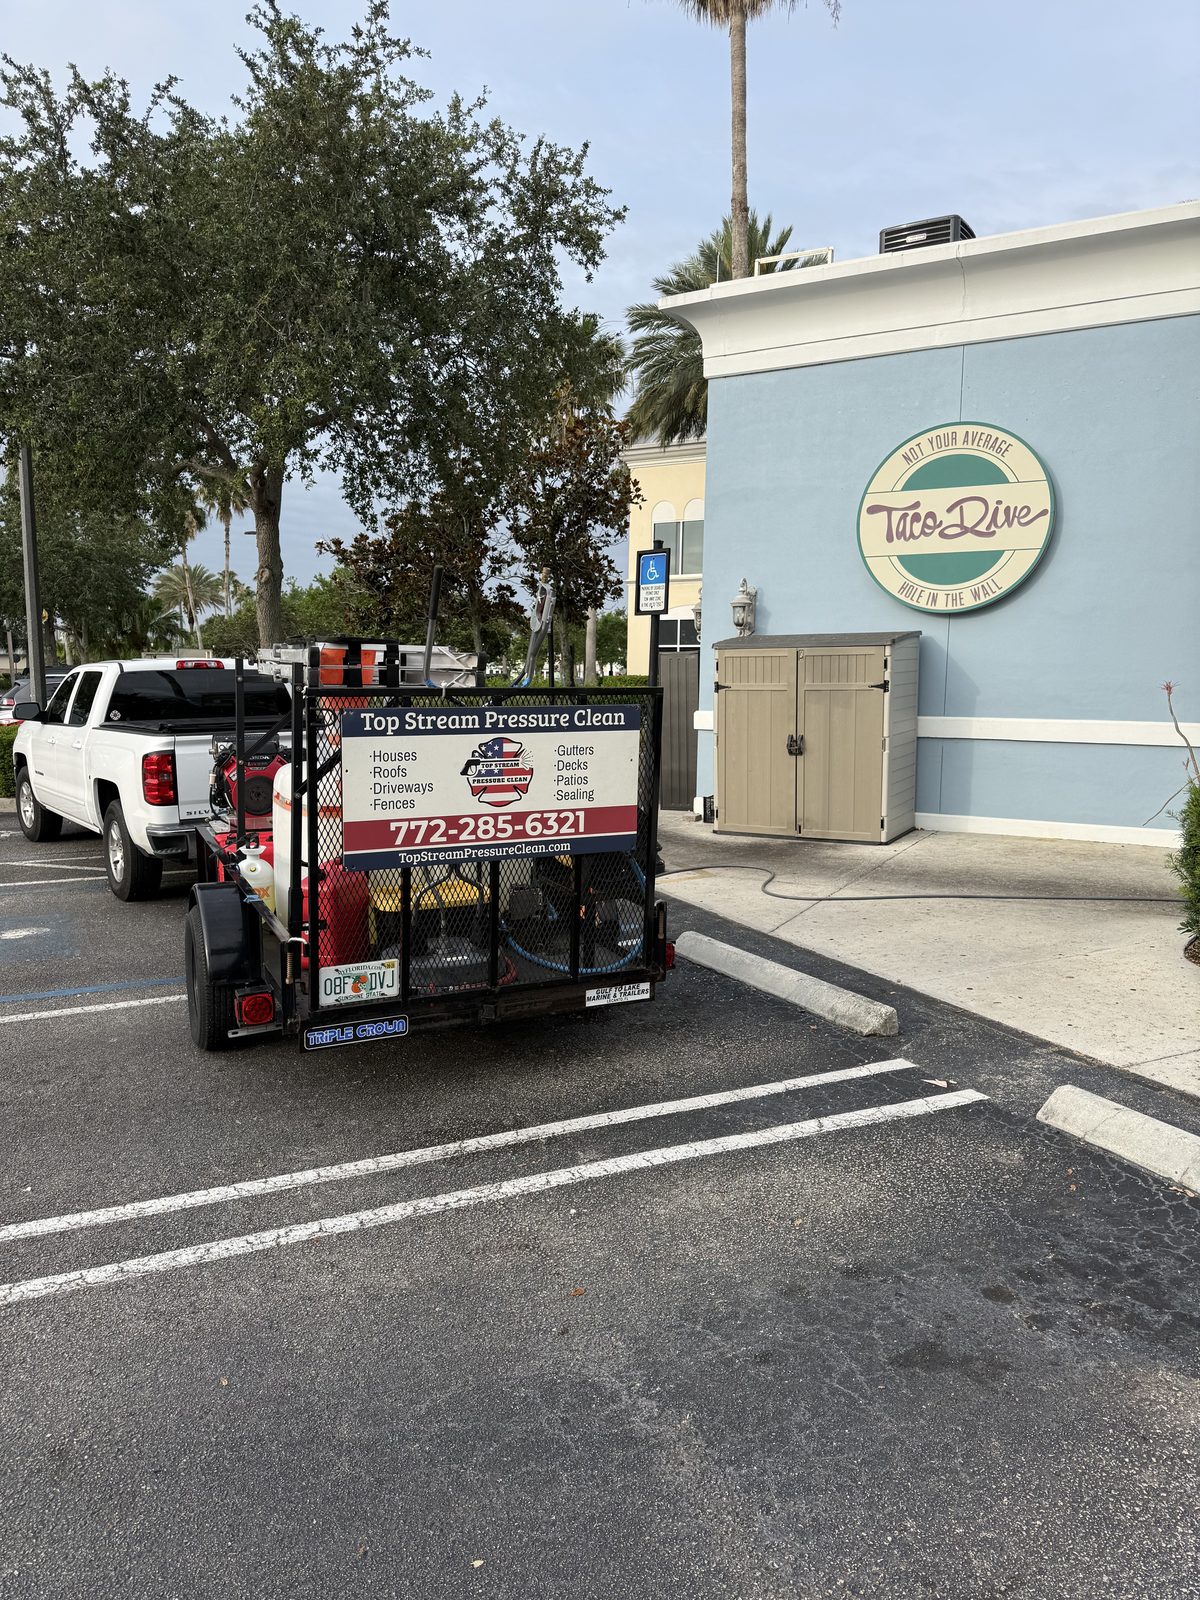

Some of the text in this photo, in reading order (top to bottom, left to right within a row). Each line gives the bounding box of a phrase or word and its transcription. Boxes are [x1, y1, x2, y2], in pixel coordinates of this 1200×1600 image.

[901, 430, 1013, 466] NOT YOUR AVERAGE
[866, 496, 1049, 544] Taco Dive
[897, 578, 1003, 608] HOLE IN THE WALL
[360, 709, 625, 735] Top Stream Pressure Clean
[389, 811, 586, 846] 772-285-6321
[398, 841, 571, 865] TopStreamPressureClean.com
[369, 970, 395, 991] DVJ
[623, 983, 641, 991] LAKE
[338, 991, 382, 1001] SUNSHINE STATE
[587, 994, 611, 1002] MARINE
[619, 989, 649, 998] TRAILERS
[307, 1019, 406, 1046] TRIPLE CROWN
